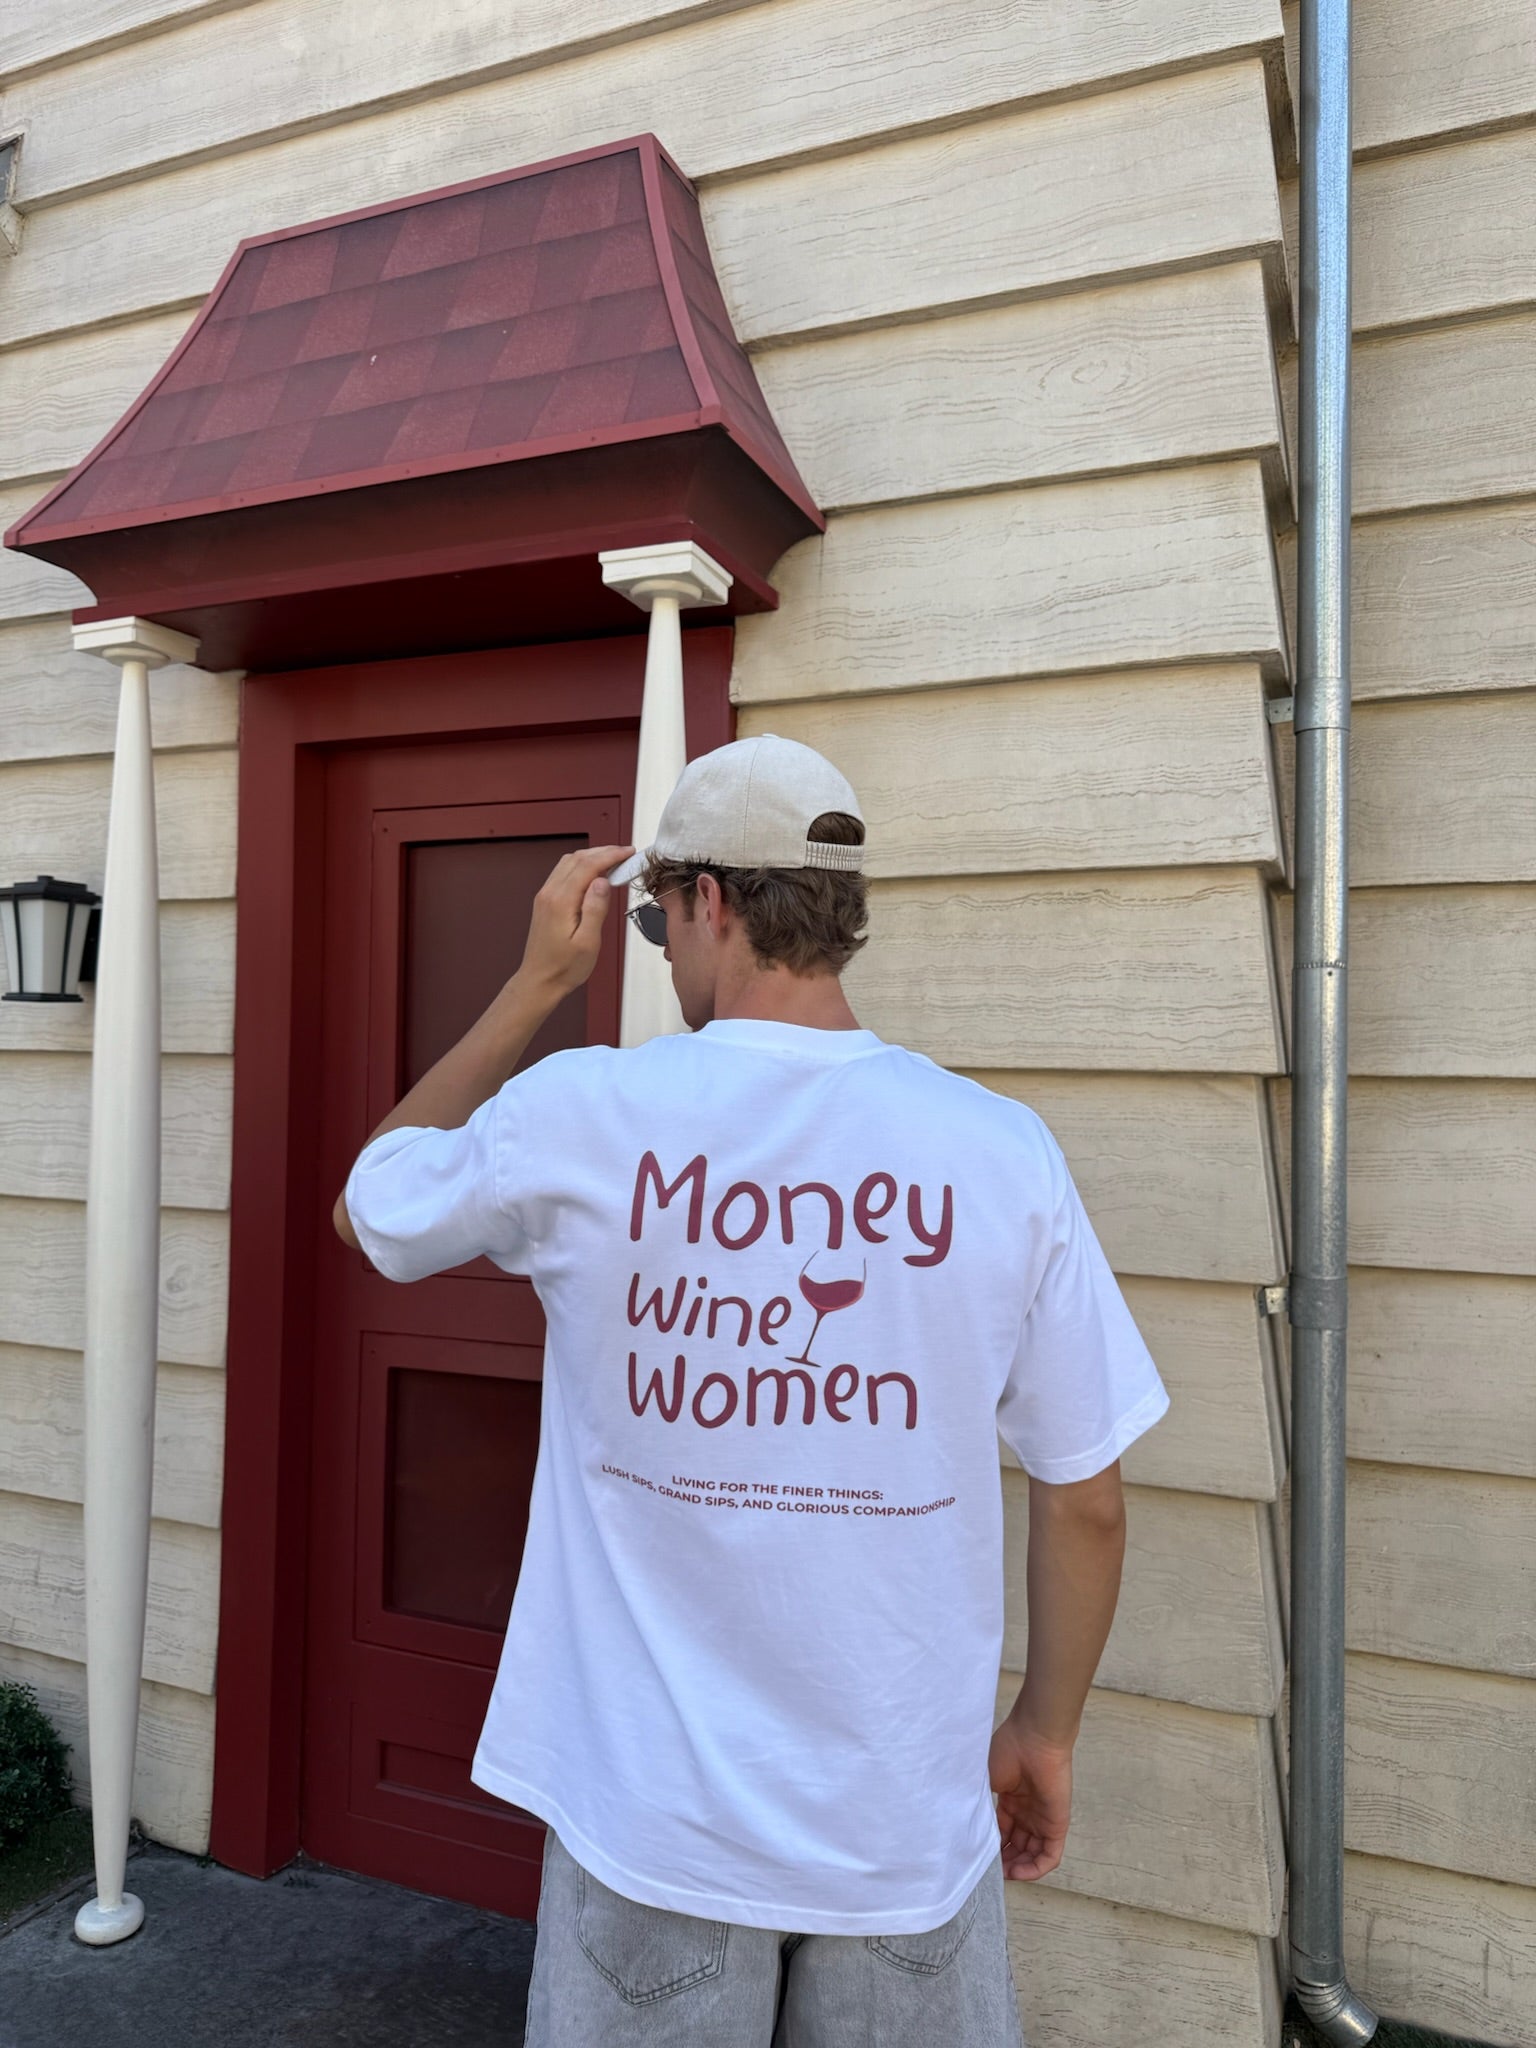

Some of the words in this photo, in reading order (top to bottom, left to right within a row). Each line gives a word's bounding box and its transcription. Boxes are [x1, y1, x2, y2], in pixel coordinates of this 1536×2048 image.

[629, 1150, 953, 1267] Money
[627, 1272, 791, 1347] Wine
[628, 1352, 917, 1430] Women
[602, 1464, 630, 1481] LUSH
[631, 1474, 657, 1493] SIPS,
[658, 1485, 702, 1505] GRAND
[704, 1496, 739, 1510] SIPS,
[742, 1499, 773, 1511] AND
[776, 1501, 849, 1515] GLORIOUS
[852, 1496, 957, 1517] COMPANIONSHIP
[671, 1475, 716, 1491] LIVING
[719, 1482, 748, 1493] FOR
[751, 1483, 778, 1495] THE
[782, 1485, 823, 1498] FINER
[827, 1488, 884, 1501] THINGS:
